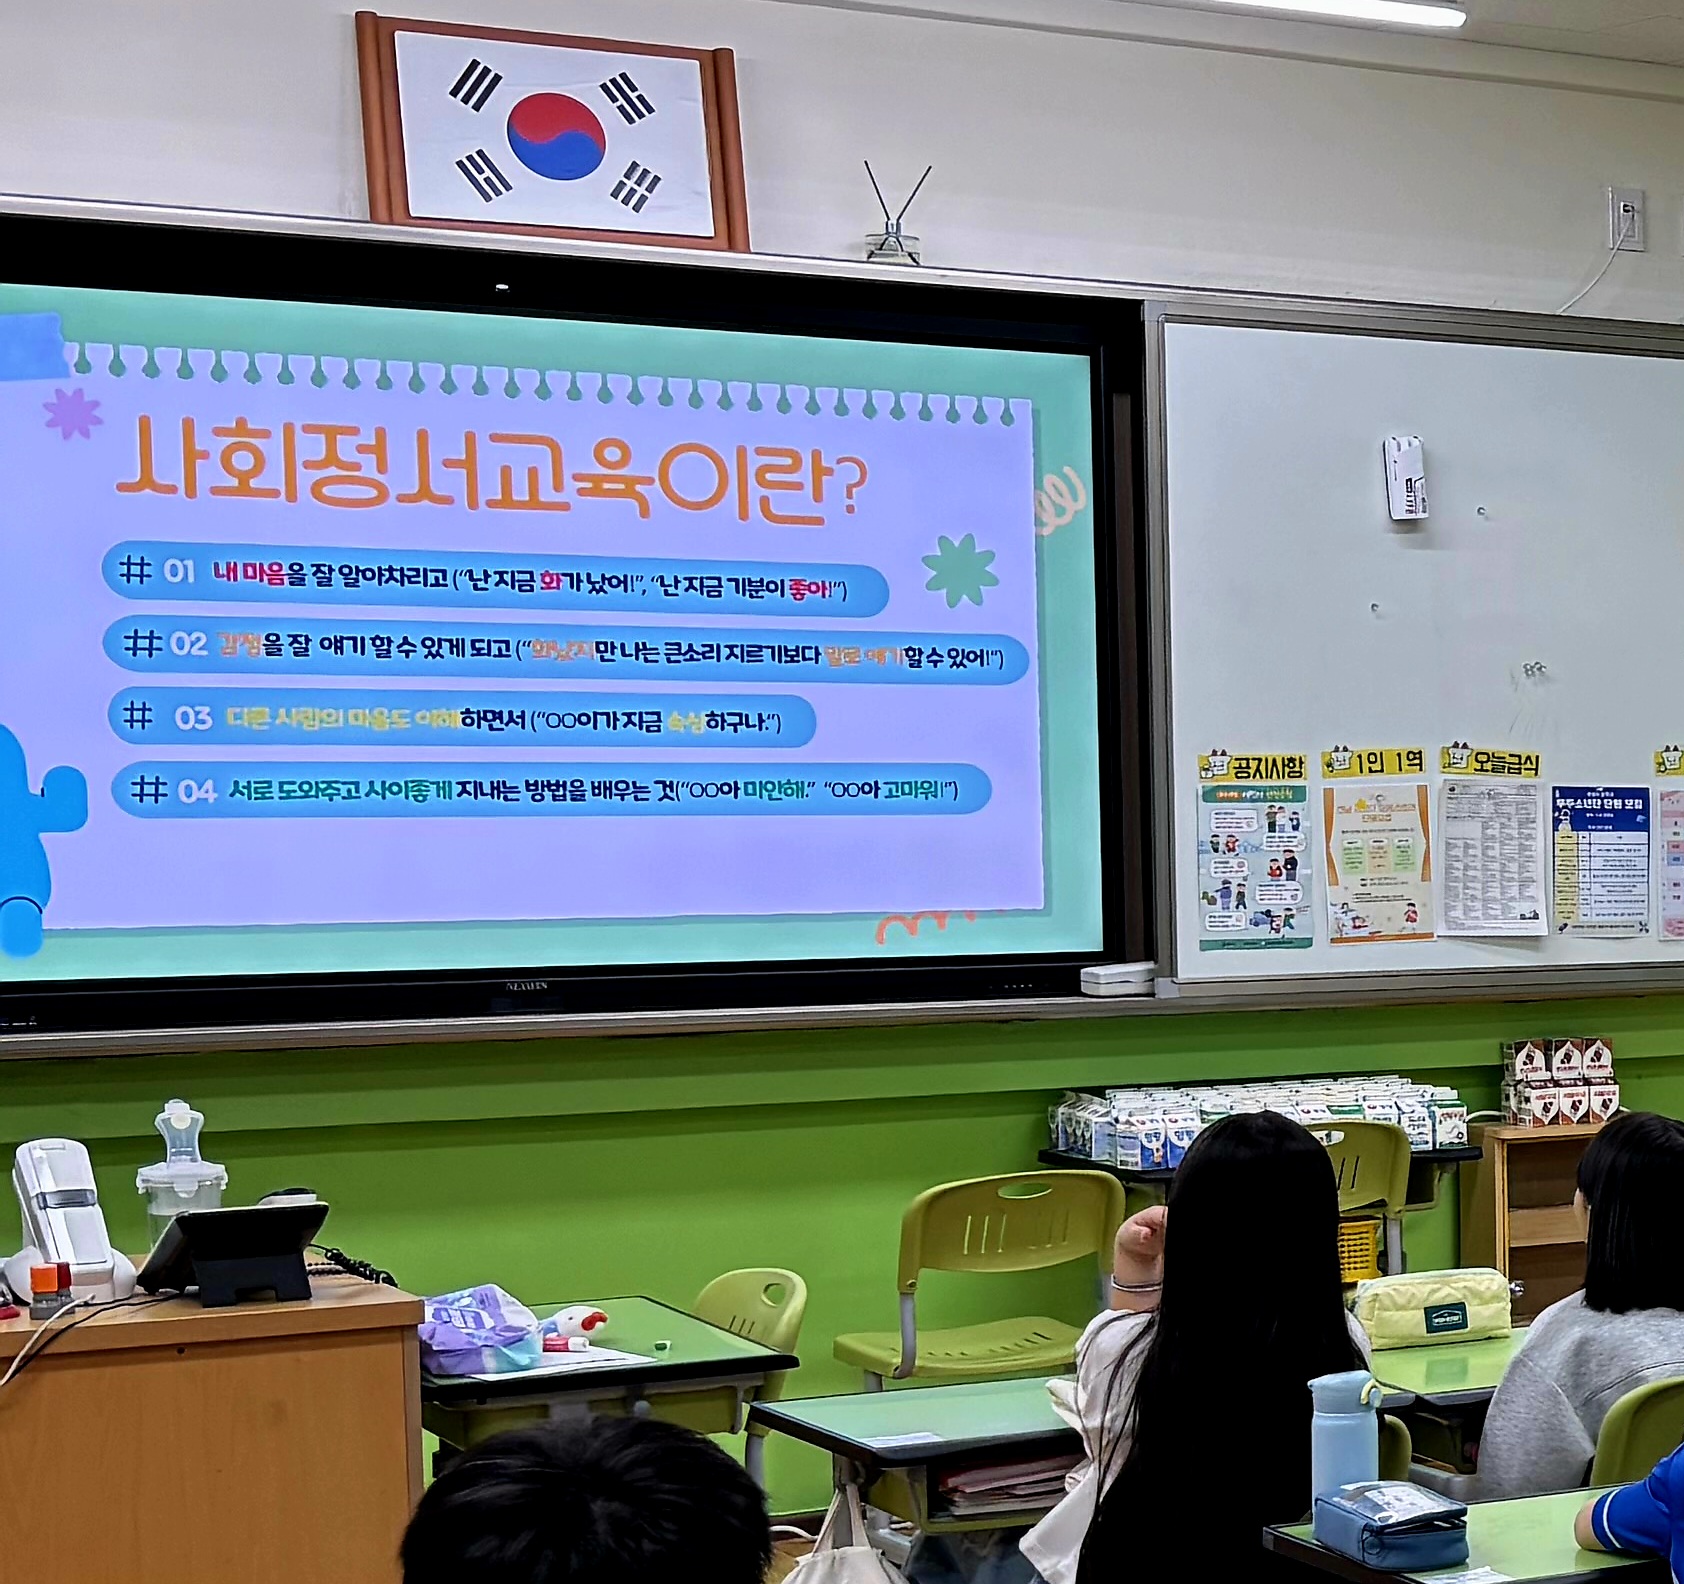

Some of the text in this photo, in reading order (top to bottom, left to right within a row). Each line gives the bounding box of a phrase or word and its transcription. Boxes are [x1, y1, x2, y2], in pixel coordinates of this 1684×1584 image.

[116, 414, 869, 525] 사회정서교육이란?
[163, 558, 195, 583] 01
[213, 561, 238, 583] 내
[243, 562, 307, 587] 마음을
[311, 563, 334, 588] 잘
[338, 564, 449, 588] 알아차리고
[494, 569, 536, 593] 지금
[540, 570, 584, 594] 화가
[683, 575, 723, 598] 지금
[726, 577, 785, 600] 기분이
[169, 631, 208, 656] 02
[288, 633, 312, 658] 잘
[470, 637, 512, 659] 되고
[620, 640, 660, 664] 나는
[664, 641, 721, 665] 큰소리
[724, 643, 822, 666] 지르기보다
[174, 705, 214, 731] 03
[623, 711, 663, 734] 지금
[1233, 755, 1305, 779] 공지사항
[1356, 749, 1423, 774] 1인 1역
[1473, 751, 1540, 777] 오늘급식
[177, 779, 217, 804] 04
[229, 780, 274, 801] 서로
[278, 780, 363, 802] 도와주고
[365, 780, 453, 803] 사이좋게
[456, 779, 521, 803] 지내는
[524, 779, 588, 803] 방법을
[591, 779, 652, 802] 배우는
